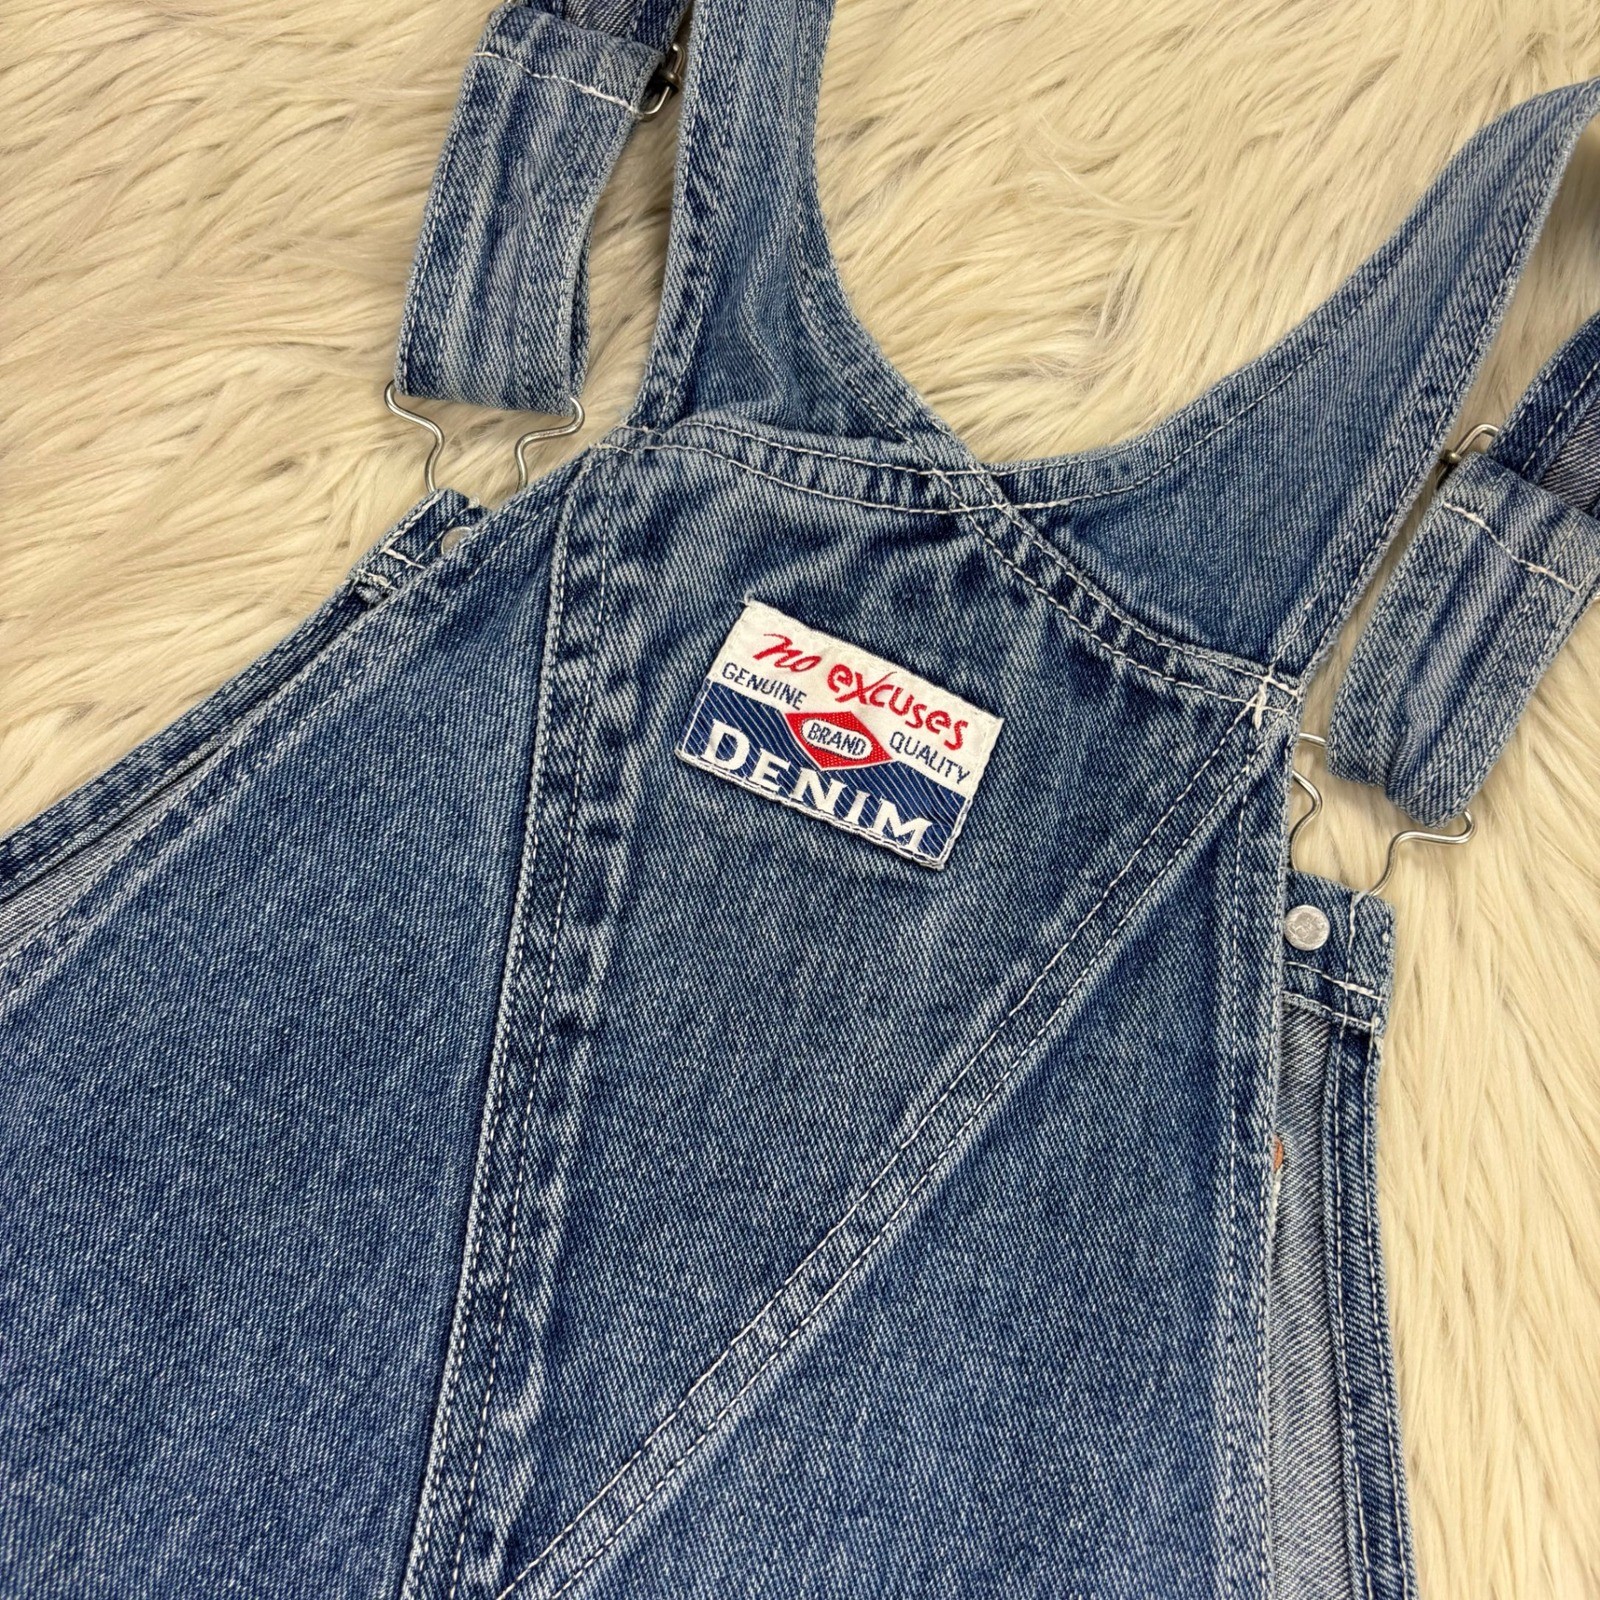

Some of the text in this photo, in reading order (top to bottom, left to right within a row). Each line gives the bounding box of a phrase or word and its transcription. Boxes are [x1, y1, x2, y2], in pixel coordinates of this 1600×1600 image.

[721, 661, 971, 785] GENUINE QUALITY
[753, 633, 969, 751] no excuses
[807, 722, 867, 756] BRAND
[701, 718, 933, 850] DENIM
